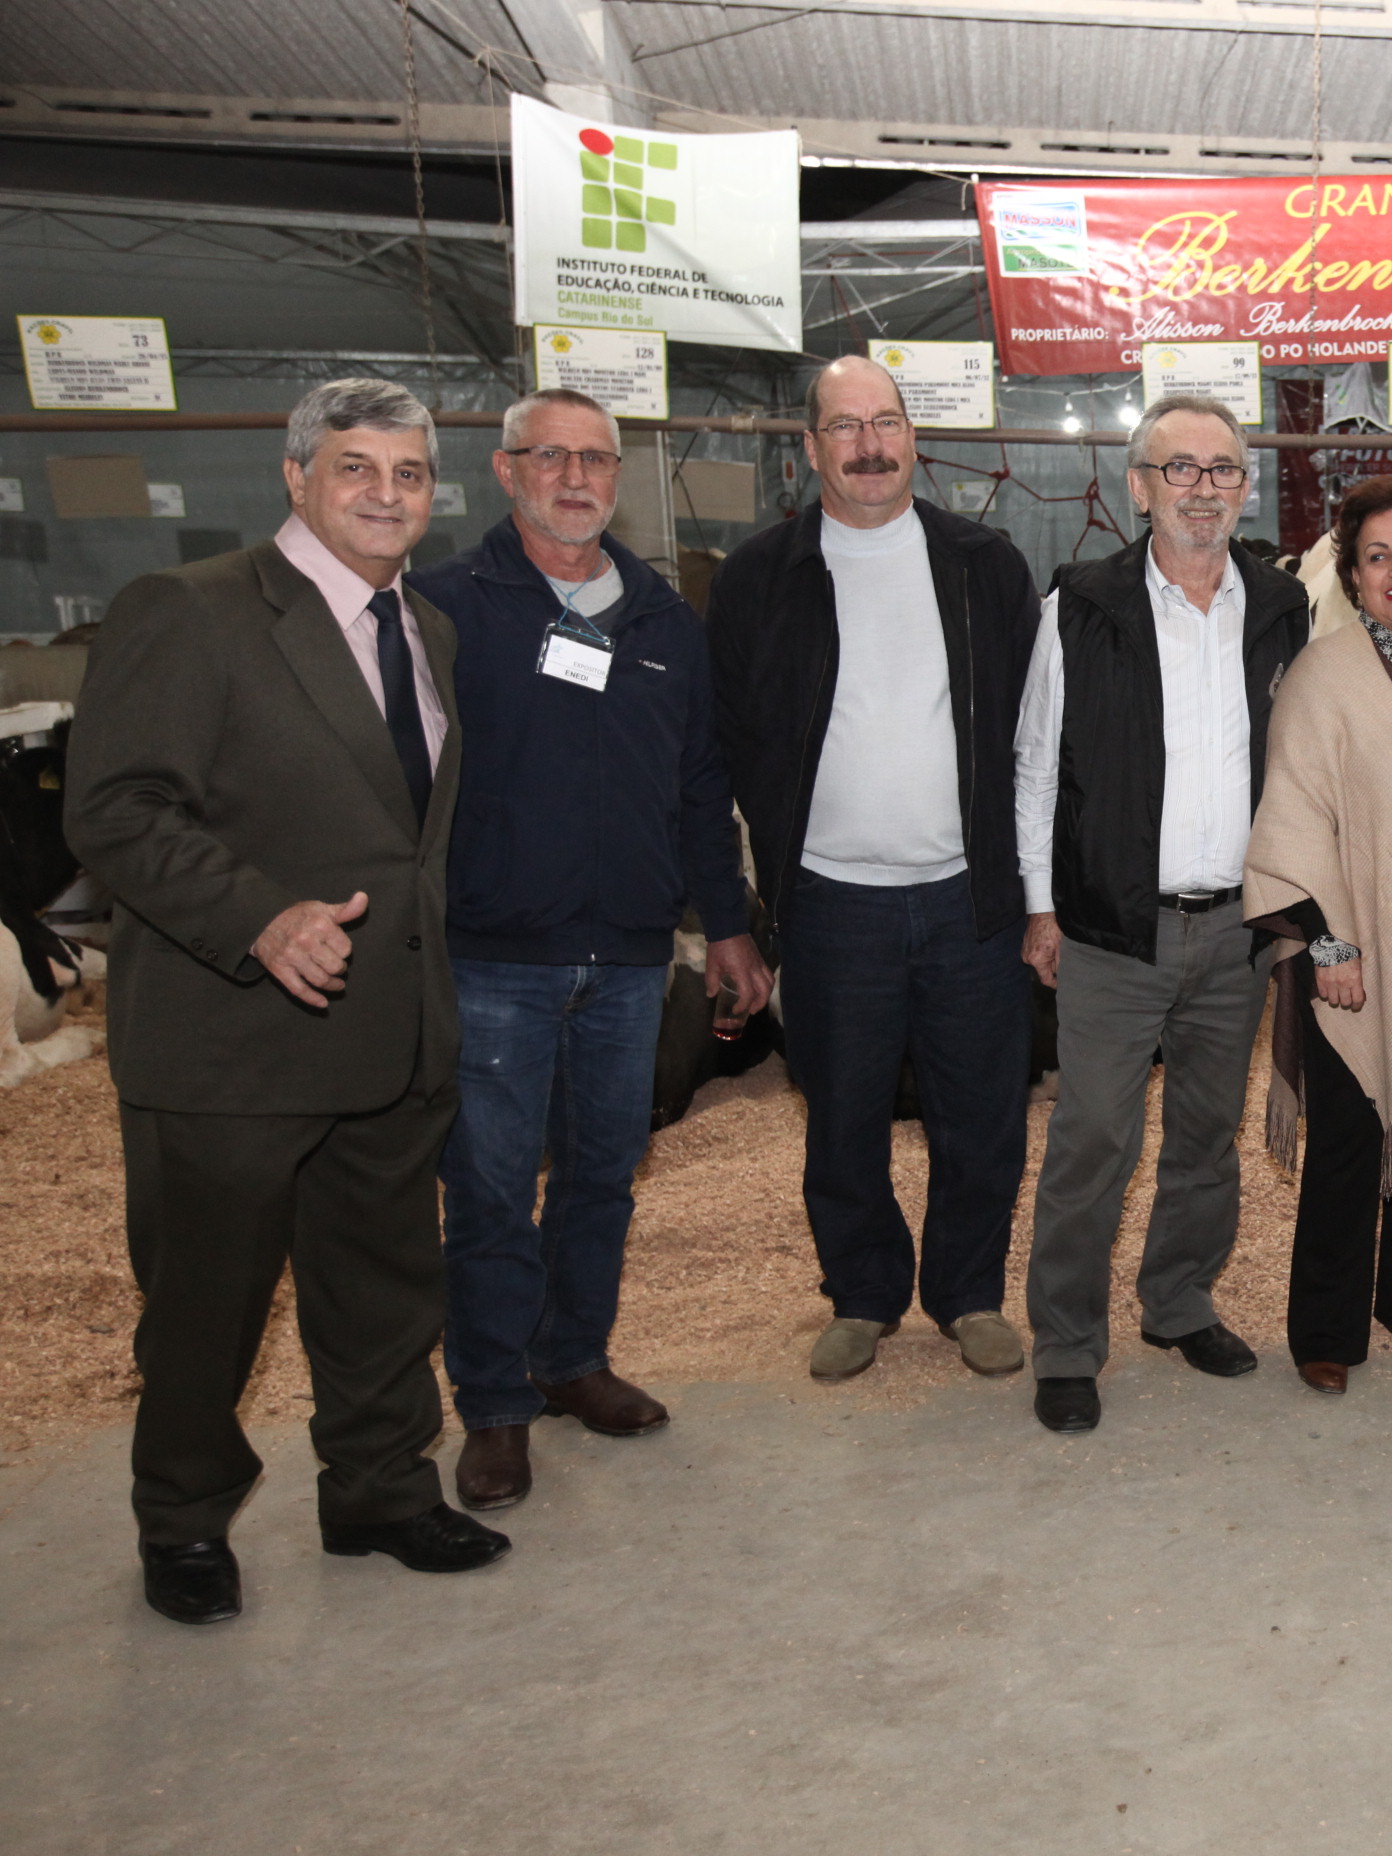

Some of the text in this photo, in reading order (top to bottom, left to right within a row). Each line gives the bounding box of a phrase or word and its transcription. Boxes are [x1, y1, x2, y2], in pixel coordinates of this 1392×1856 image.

[557, 256, 709, 284] INSTITUTO FEDERAL DE
[557, 274, 784, 308] EDUCAÇÃO, CIÊNCIA E TECNOLOGIA
[557, 289, 643, 311] CATARINENSE
[557, 307, 653, 326] Campus Rio do Sul
[1010, 326, 1110, 342] PROPRIETÁRIO:
[1120, 306, 1225, 342] Alisson
[132, 334, 149, 348] 73
[635, 346, 655, 360] 128
[963, 358, 980, 371] 115
[1232, 356, 1246, 369] 99
[564, 669, 589, 683] ENEDI
[573, 660, 606, 677] EXPOSITOR
